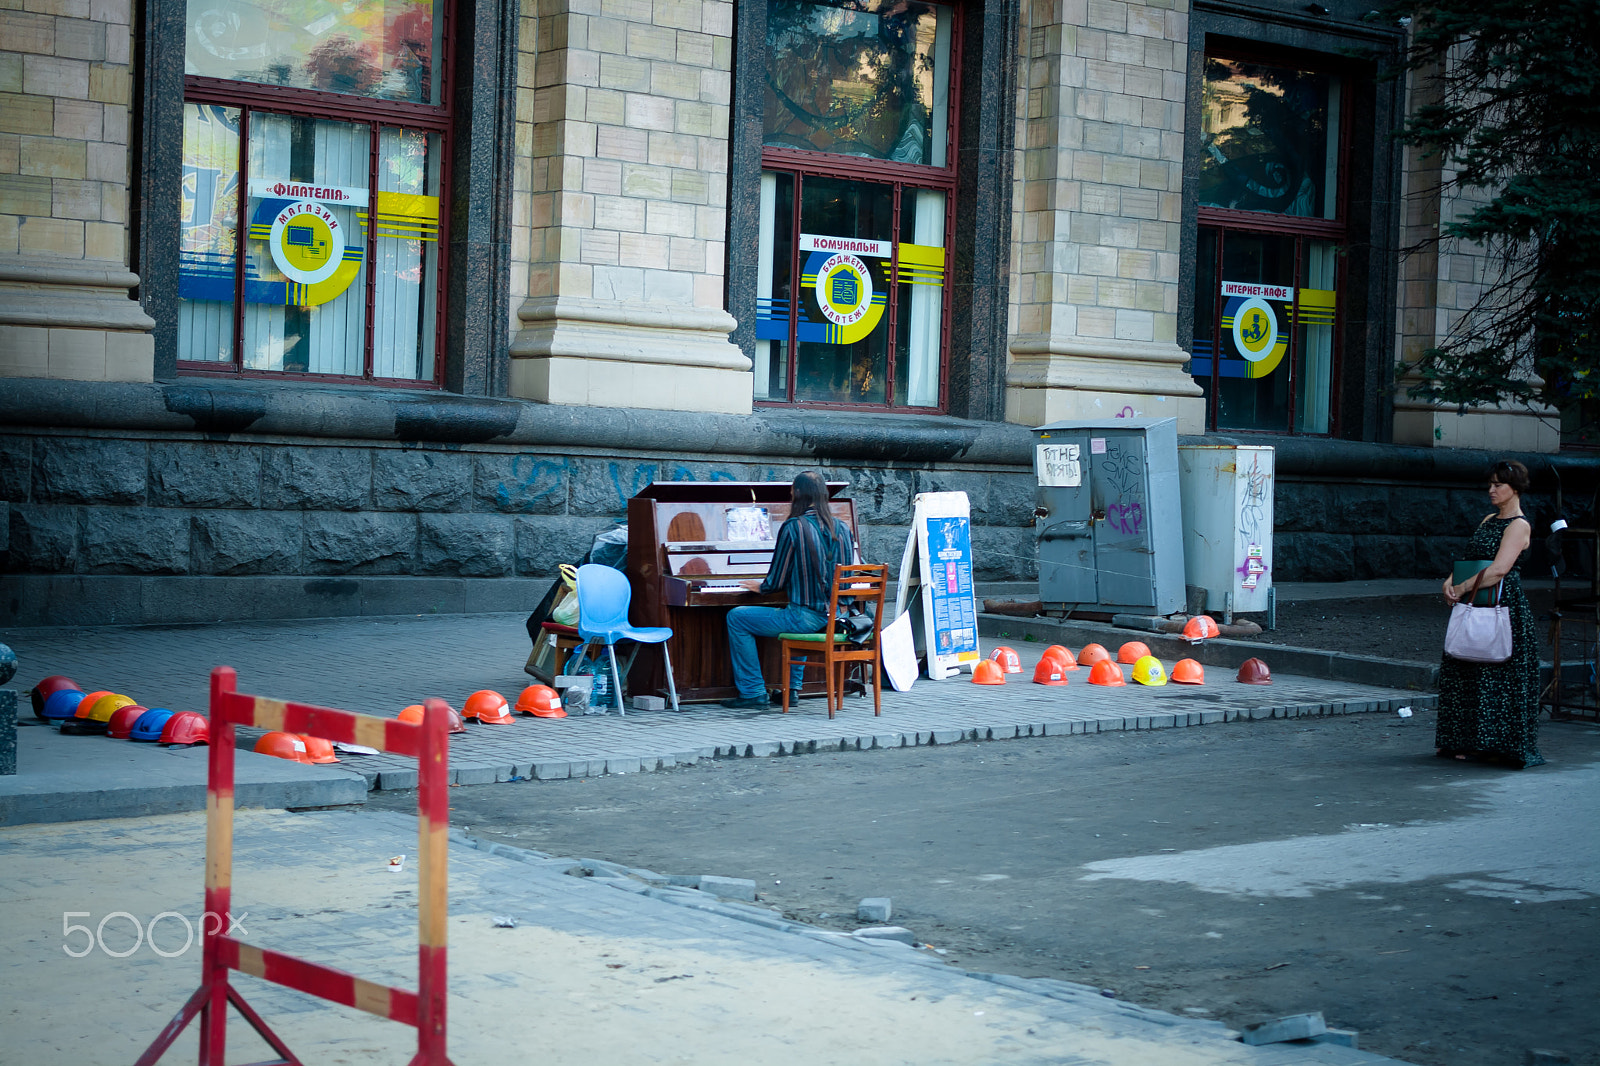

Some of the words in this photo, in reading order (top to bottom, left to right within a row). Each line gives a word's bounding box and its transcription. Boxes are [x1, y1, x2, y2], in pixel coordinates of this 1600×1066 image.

[278, 204, 338, 229] МАГАЗИН
[813, 238, 879, 253] КОМУНАЛЬНІ
[823, 254, 867, 275] БЮДЖЕТНІ
[1225, 284, 1287, 298] ІНТЕРНЕТ-КАФЕ
[822, 304, 866, 324] ПЛАТЕЖІ
